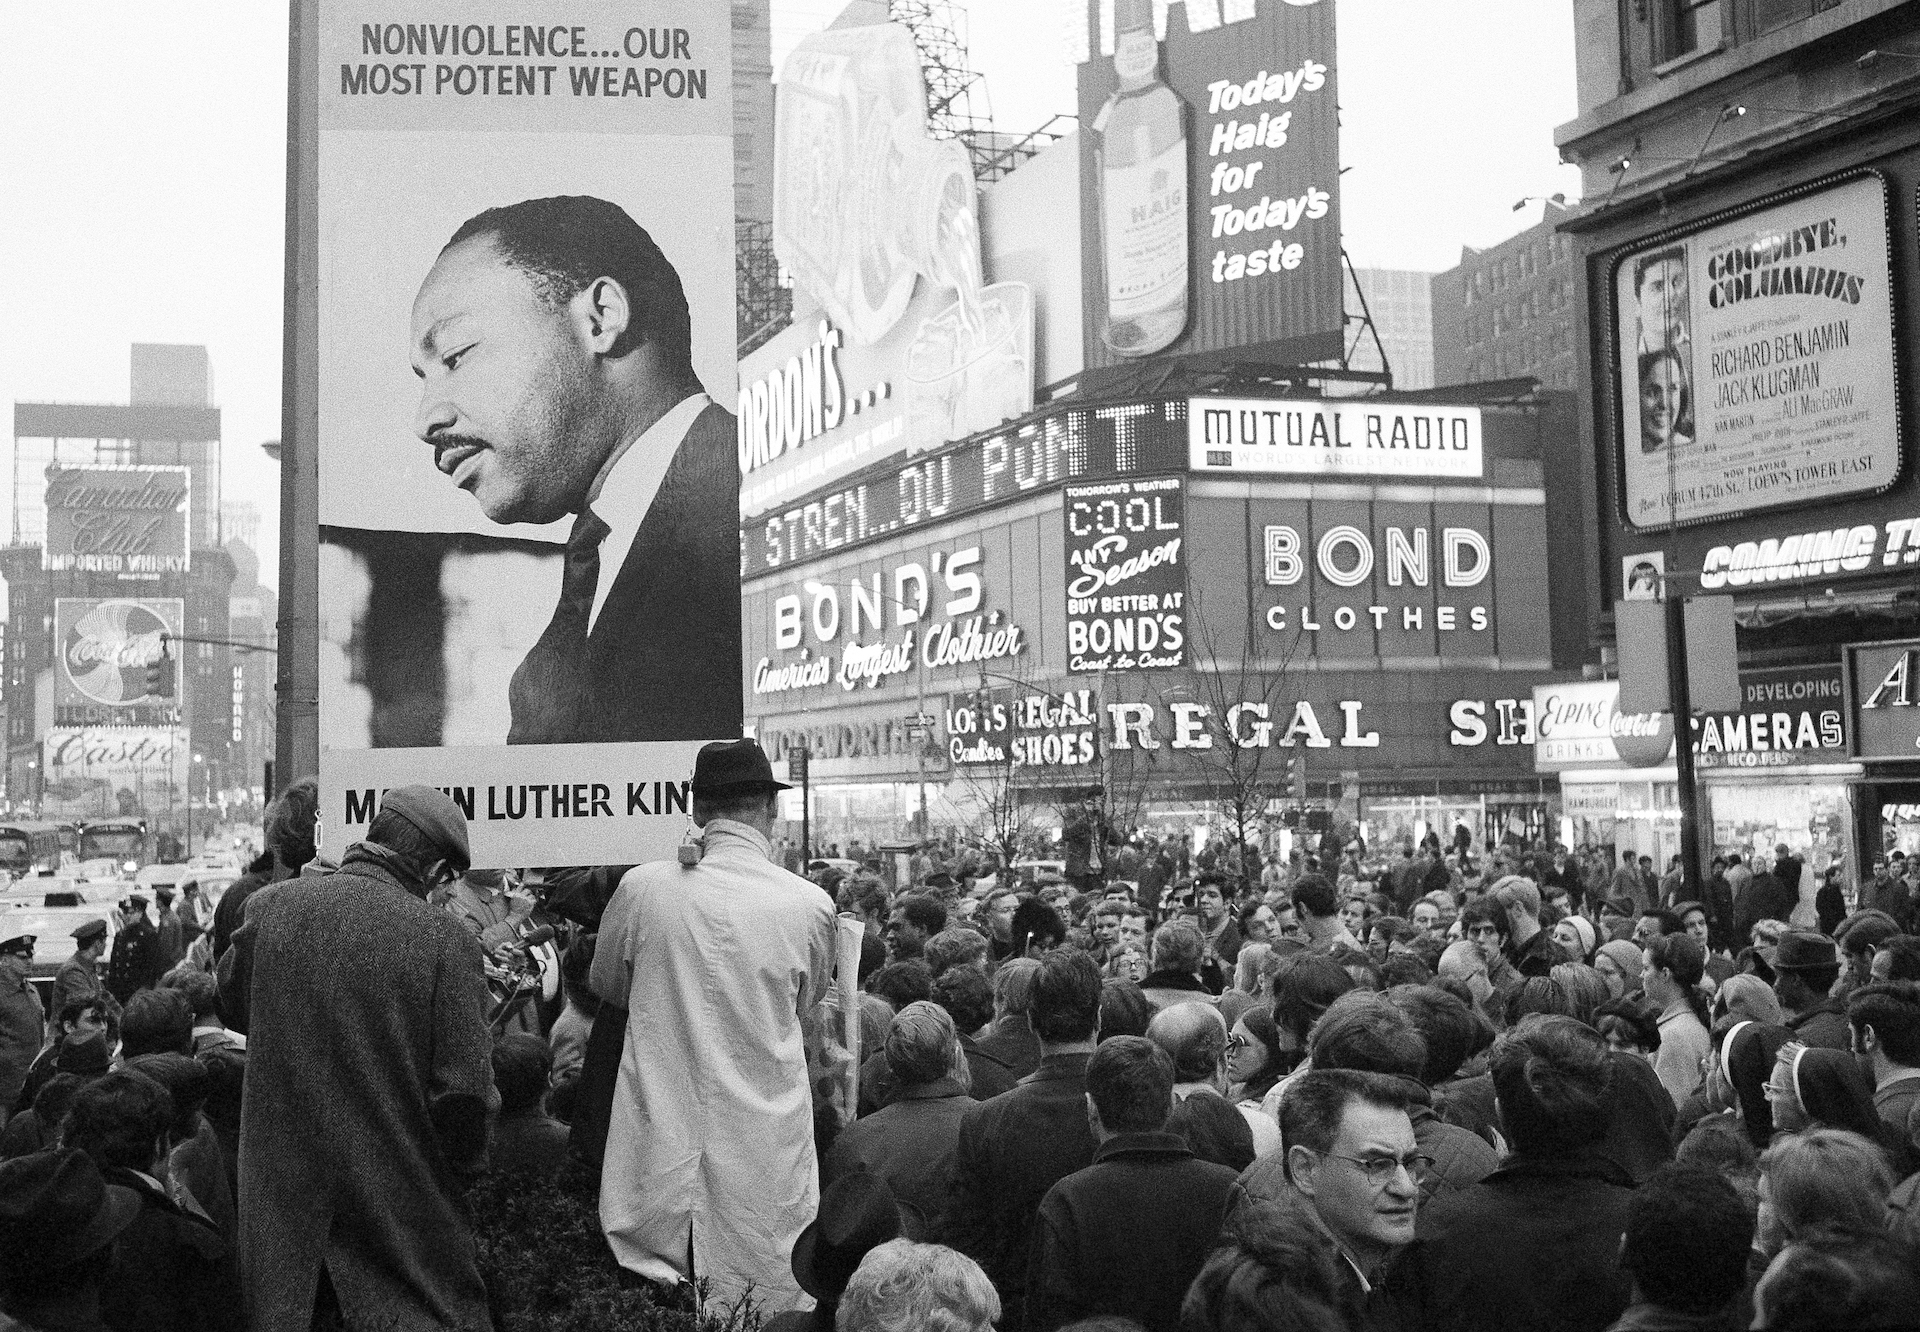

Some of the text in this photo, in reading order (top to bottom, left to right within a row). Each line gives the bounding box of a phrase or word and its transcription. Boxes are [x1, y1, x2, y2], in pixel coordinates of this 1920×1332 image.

[340, 64, 708, 99] MOST POTENT WEAPON
[1207, 59, 1328, 114] Today's
[1208, 111, 1292, 156] Haig
[1210, 162, 1263, 196] for
[1130, 190, 1181, 225] HAIG
[1210, 187, 1330, 239] Today's
[1211, 240, 1304, 283] taste
[1709, 265, 1865, 309] COLUMBUS
[1711, 319, 1849, 379] RICHARD BENJAMIN
[738, 320, 888, 476] ORDON'S...
[1714, 361, 1820, 410] JACK KLUGMAN
[1782, 396, 1798, 420] ALI
[1801, 384, 1855, 416] MacGRAW
[1204, 409, 1469, 451] MUTUAL RADIO
[1237, 451, 1306, 464] WORLD'S
[1313, 453, 1386, 467] LARGEST
[1393, 455, 1470, 470] NETWORK
[1724, 459, 1787, 479] NOW PLAYING
[1748, 471, 1792, 492] LOEW'S
[1796, 460, 1837, 484] TOWER
[1842, 455, 1873, 475] EAST
[1066, 479, 1180, 497] TOMORROW'S WEATHER
[71, 509, 164, 555] Club
[1069, 496, 1179, 536] COOL
[46, 554, 186, 572] IMPORTED WHISKY
[1067, 535, 1181, 598] Season
[1070, 547, 1111, 565] ANY
[1264, 525, 1491, 587] BOND
[1701, 524, 1877, 589] COMING
[775, 547, 983, 650] BOND'S
[1067, 592, 1183, 615] BUY BETTER AT
[1266, 606, 1488, 631] CLOTHES
[836, 629, 914, 691] Largest
[922, 608, 1022, 669] Clothier
[1068, 612, 1183, 655] BOND'S
[1070, 651, 1183, 671] Coast to Coast
[232, 665, 243, 742] HOWARD
[1012, 689, 1097, 730] REGAL
[1747, 679, 1841, 702] DEVELOPING
[1107, 700, 1380, 751] REGAL
[1538, 695, 1607, 737] ELPINE
[1011, 732, 1094, 768] SHOES
[1546, 742, 1605, 758] DRINKS
[488, 783, 614, 821] LUTHER
[627, 780, 690, 816] KIN
